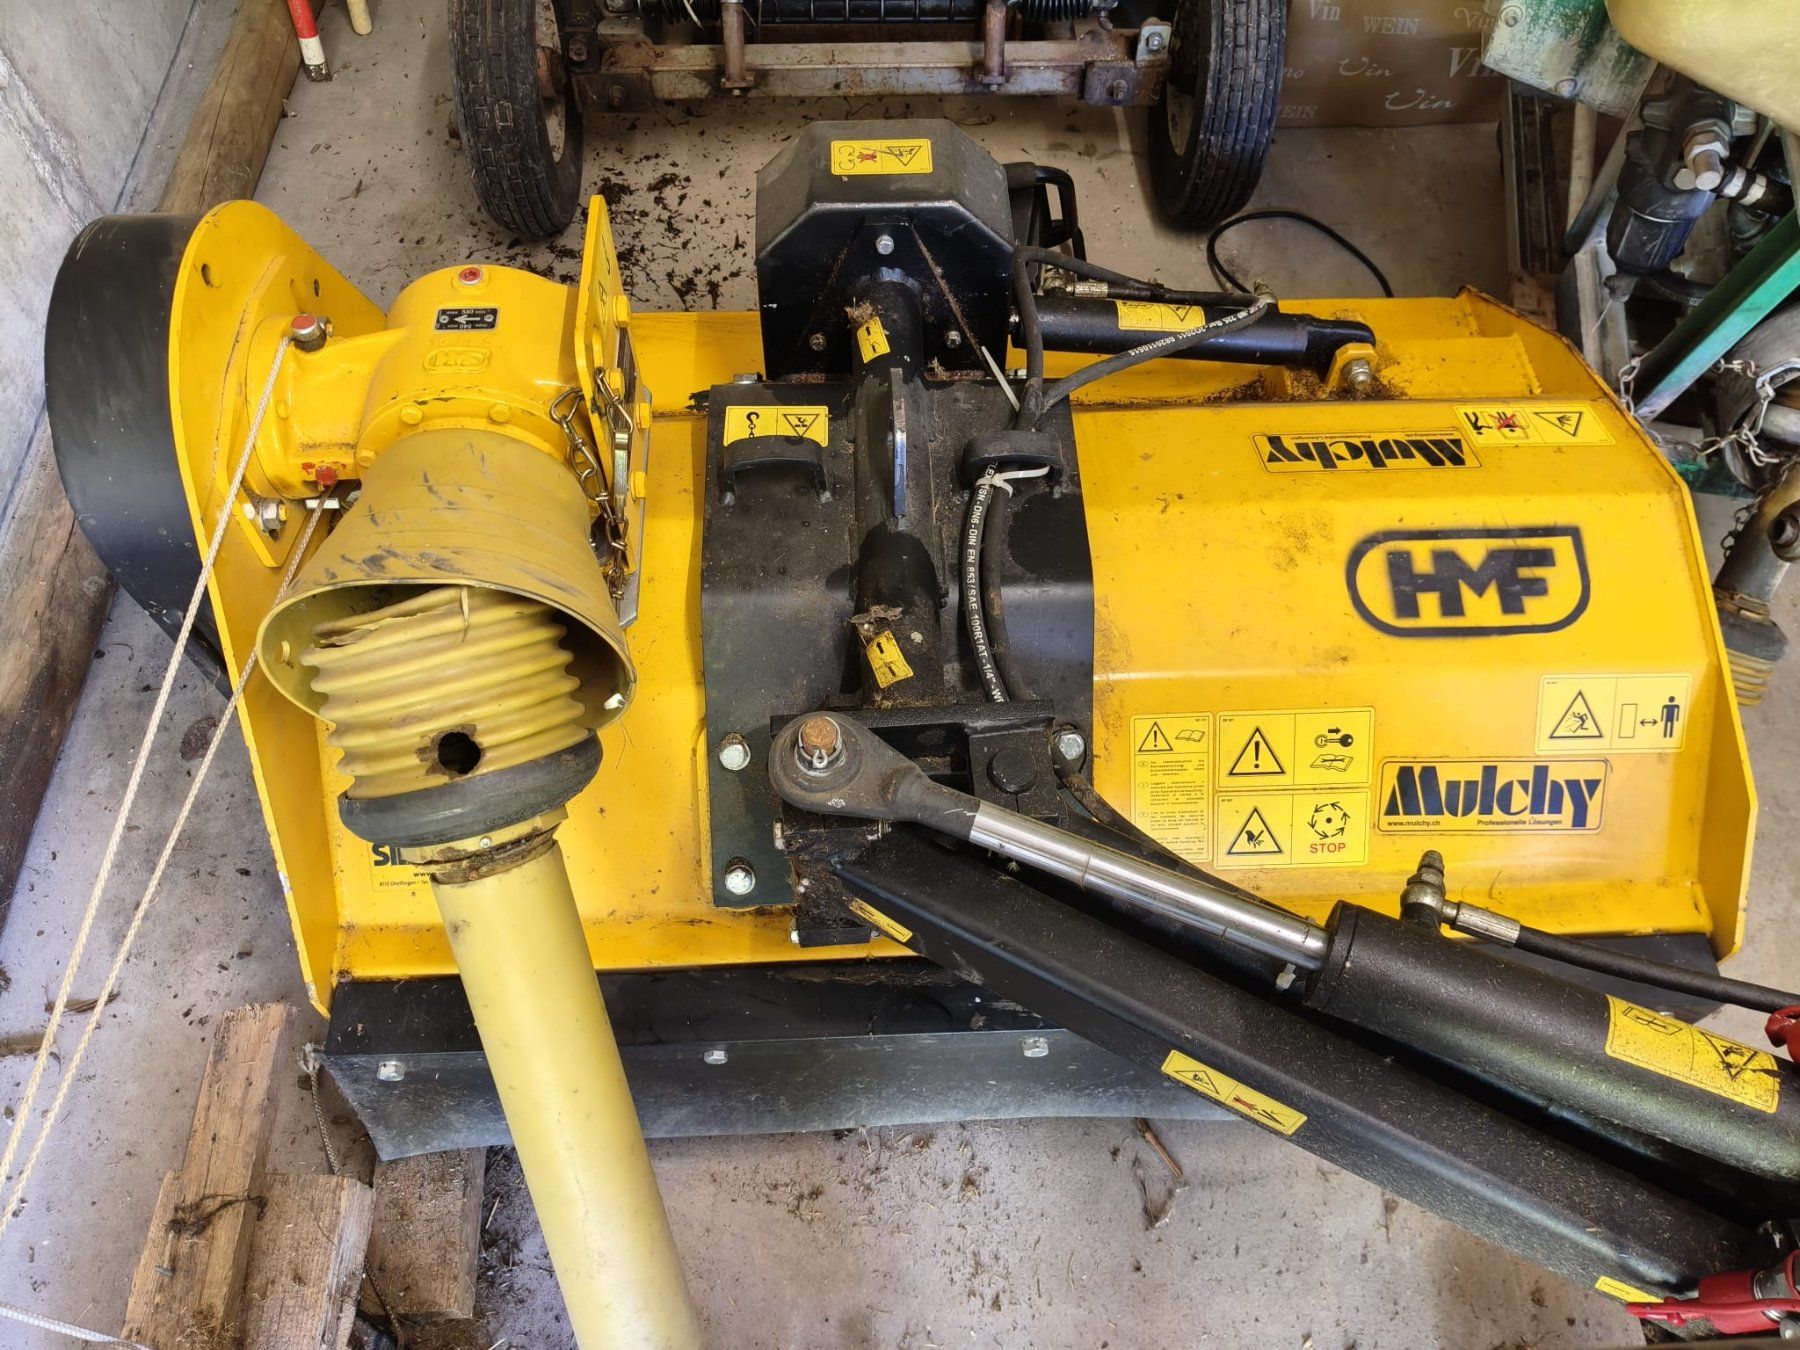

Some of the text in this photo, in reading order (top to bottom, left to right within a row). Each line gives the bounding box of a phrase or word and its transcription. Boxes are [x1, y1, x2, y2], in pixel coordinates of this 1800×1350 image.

[1309, 0, 1340, 21] Vin
[1362, 16, 1420, 35] WEIN
[1338, 56, 1395, 77] Vin
[1384, 88, 1457, 111] Vin
[1279, 105, 1319, 119] EIN
[1266, 435, 1467, 469] Mulchy
[966, 549, 976, 563] EN
[1386, 548, 1556, 618] HMF
[1384, 765, 1602, 828] Mulchy
[1476, 819, 1527, 827] Professionelle
[1528, 817, 1563, 827] Lösungen
[1309, 842, 1347, 854] STOP
